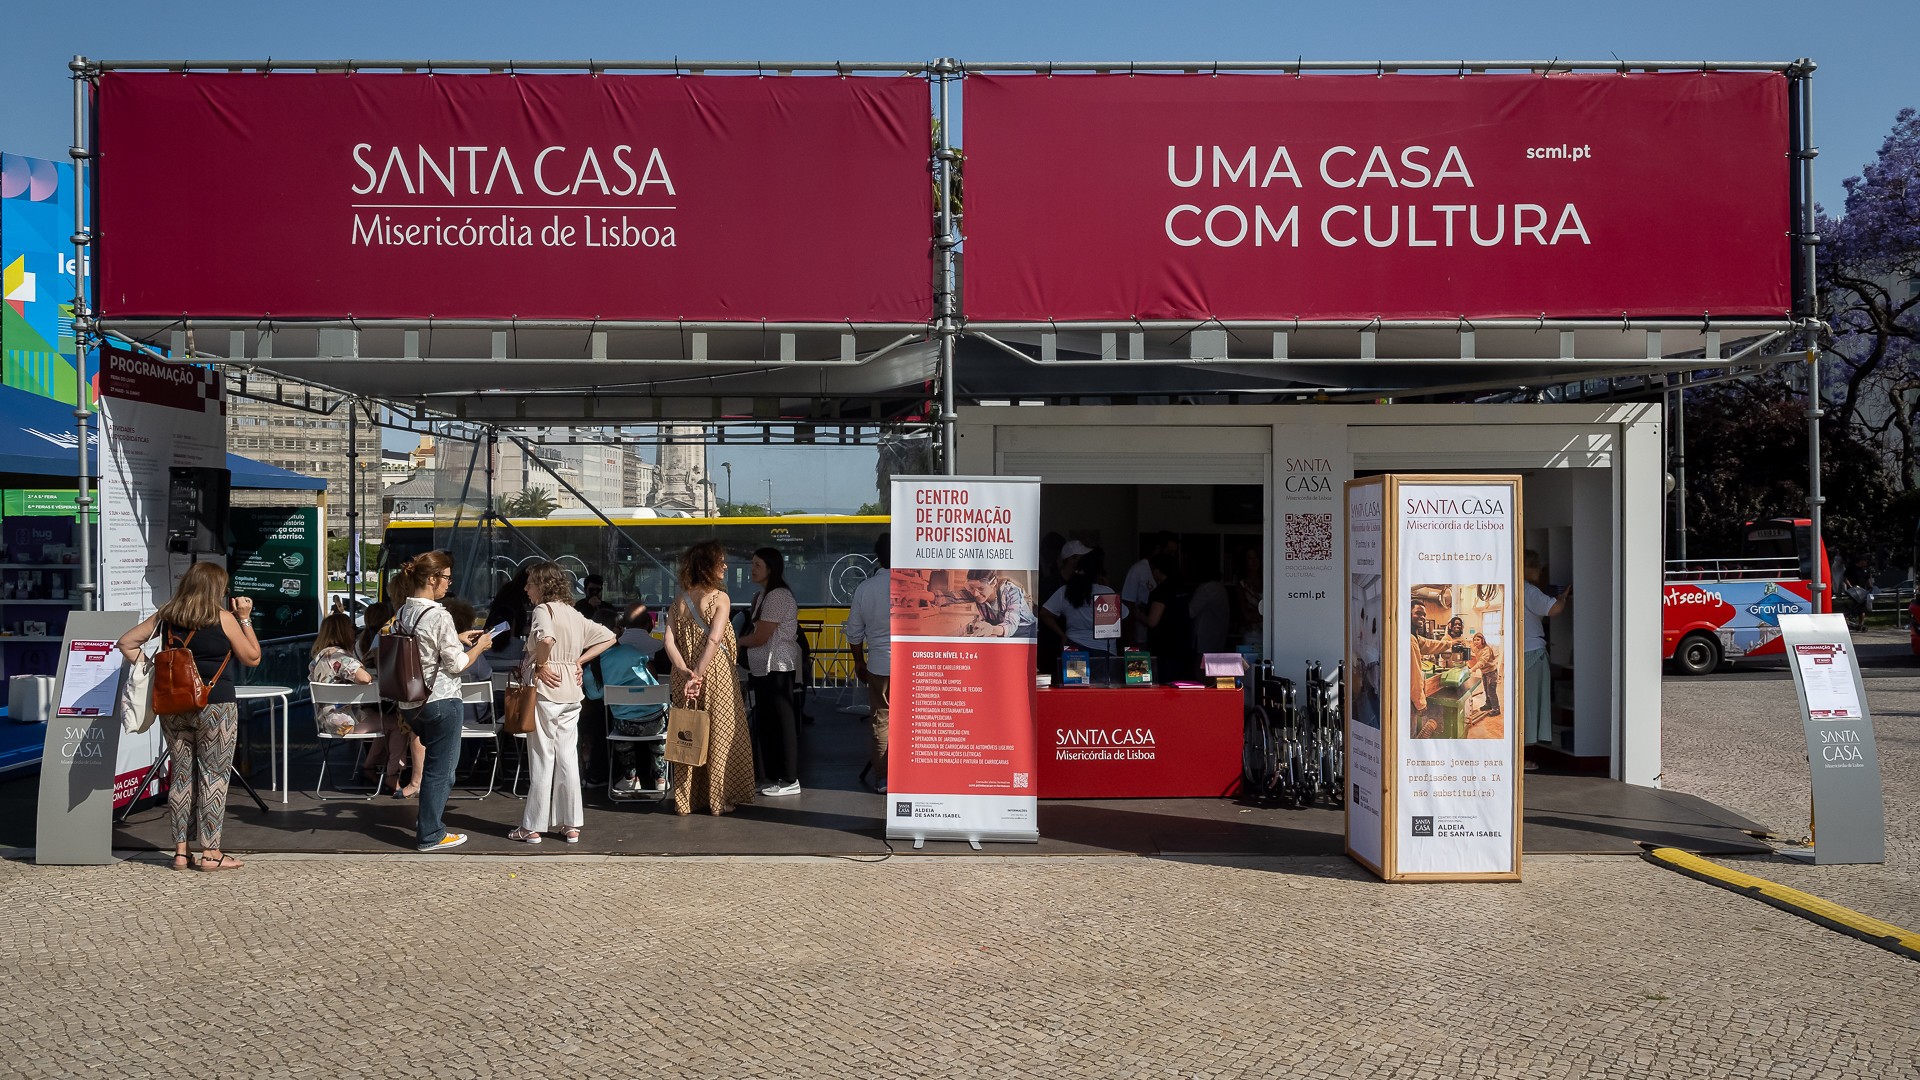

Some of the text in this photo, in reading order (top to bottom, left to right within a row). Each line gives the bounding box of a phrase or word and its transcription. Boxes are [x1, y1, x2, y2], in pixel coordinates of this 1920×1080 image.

[1526, 143, 1592, 162] scml.pt
[351, 143, 676, 197] SANTA CASA
[1167, 145, 1475, 189] UMA CASA
[351, 213, 676, 247] Misericórdia de Lisboa
[1164, 203, 1591, 248] COM CULTURA
[110, 355, 194, 386] PROGRAMAÇÃO
[1286, 457, 1332, 473] SANTA
[1285, 476, 1332, 493] CASA
[916, 489, 969, 505] CENTRO
[1364, 501, 1381, 518] CASA
[1406, 498, 1504, 515] SANTA CASA
[916, 505, 1011, 528] DE FORMAÇÃO
[1406, 519, 1505, 530] Misericórdia de Lisboa
[32, 528, 52, 541] hug
[916, 526, 1013, 543] PROFISSIONAL
[915, 547, 1014, 560] ALDEIA DE SANTA ISABEL
[1418, 552, 1493, 563] Carpinteiro/a
[1288, 590, 1326, 601] scml.pt
[1750, 603, 1800, 616] Gray Line
[912, 651, 934, 659] CURSOS
[934, 651, 942, 659] DE
[942, 650, 958, 659] NÍVEL
[64, 726, 105, 740] SANTA
[1055, 728, 1156, 745] SANTA CASA
[1820, 730, 1860, 743] SANTA
[61, 742, 103, 758] CASA
[1055, 749, 1156, 761] Misericórdia de Lisboa
[1822, 745, 1863, 762] CASA
[1406, 758, 1503, 768] Formamos jovens para
[113, 776, 139, 791] MA CASA
[1408, 773, 1458, 784] profissões
[1461, 775, 1477, 784] que
[1491, 774, 1501, 782] IA
[112, 791, 122, 802] OM
[1413, 789, 1496, 798] não substitui(rá)
